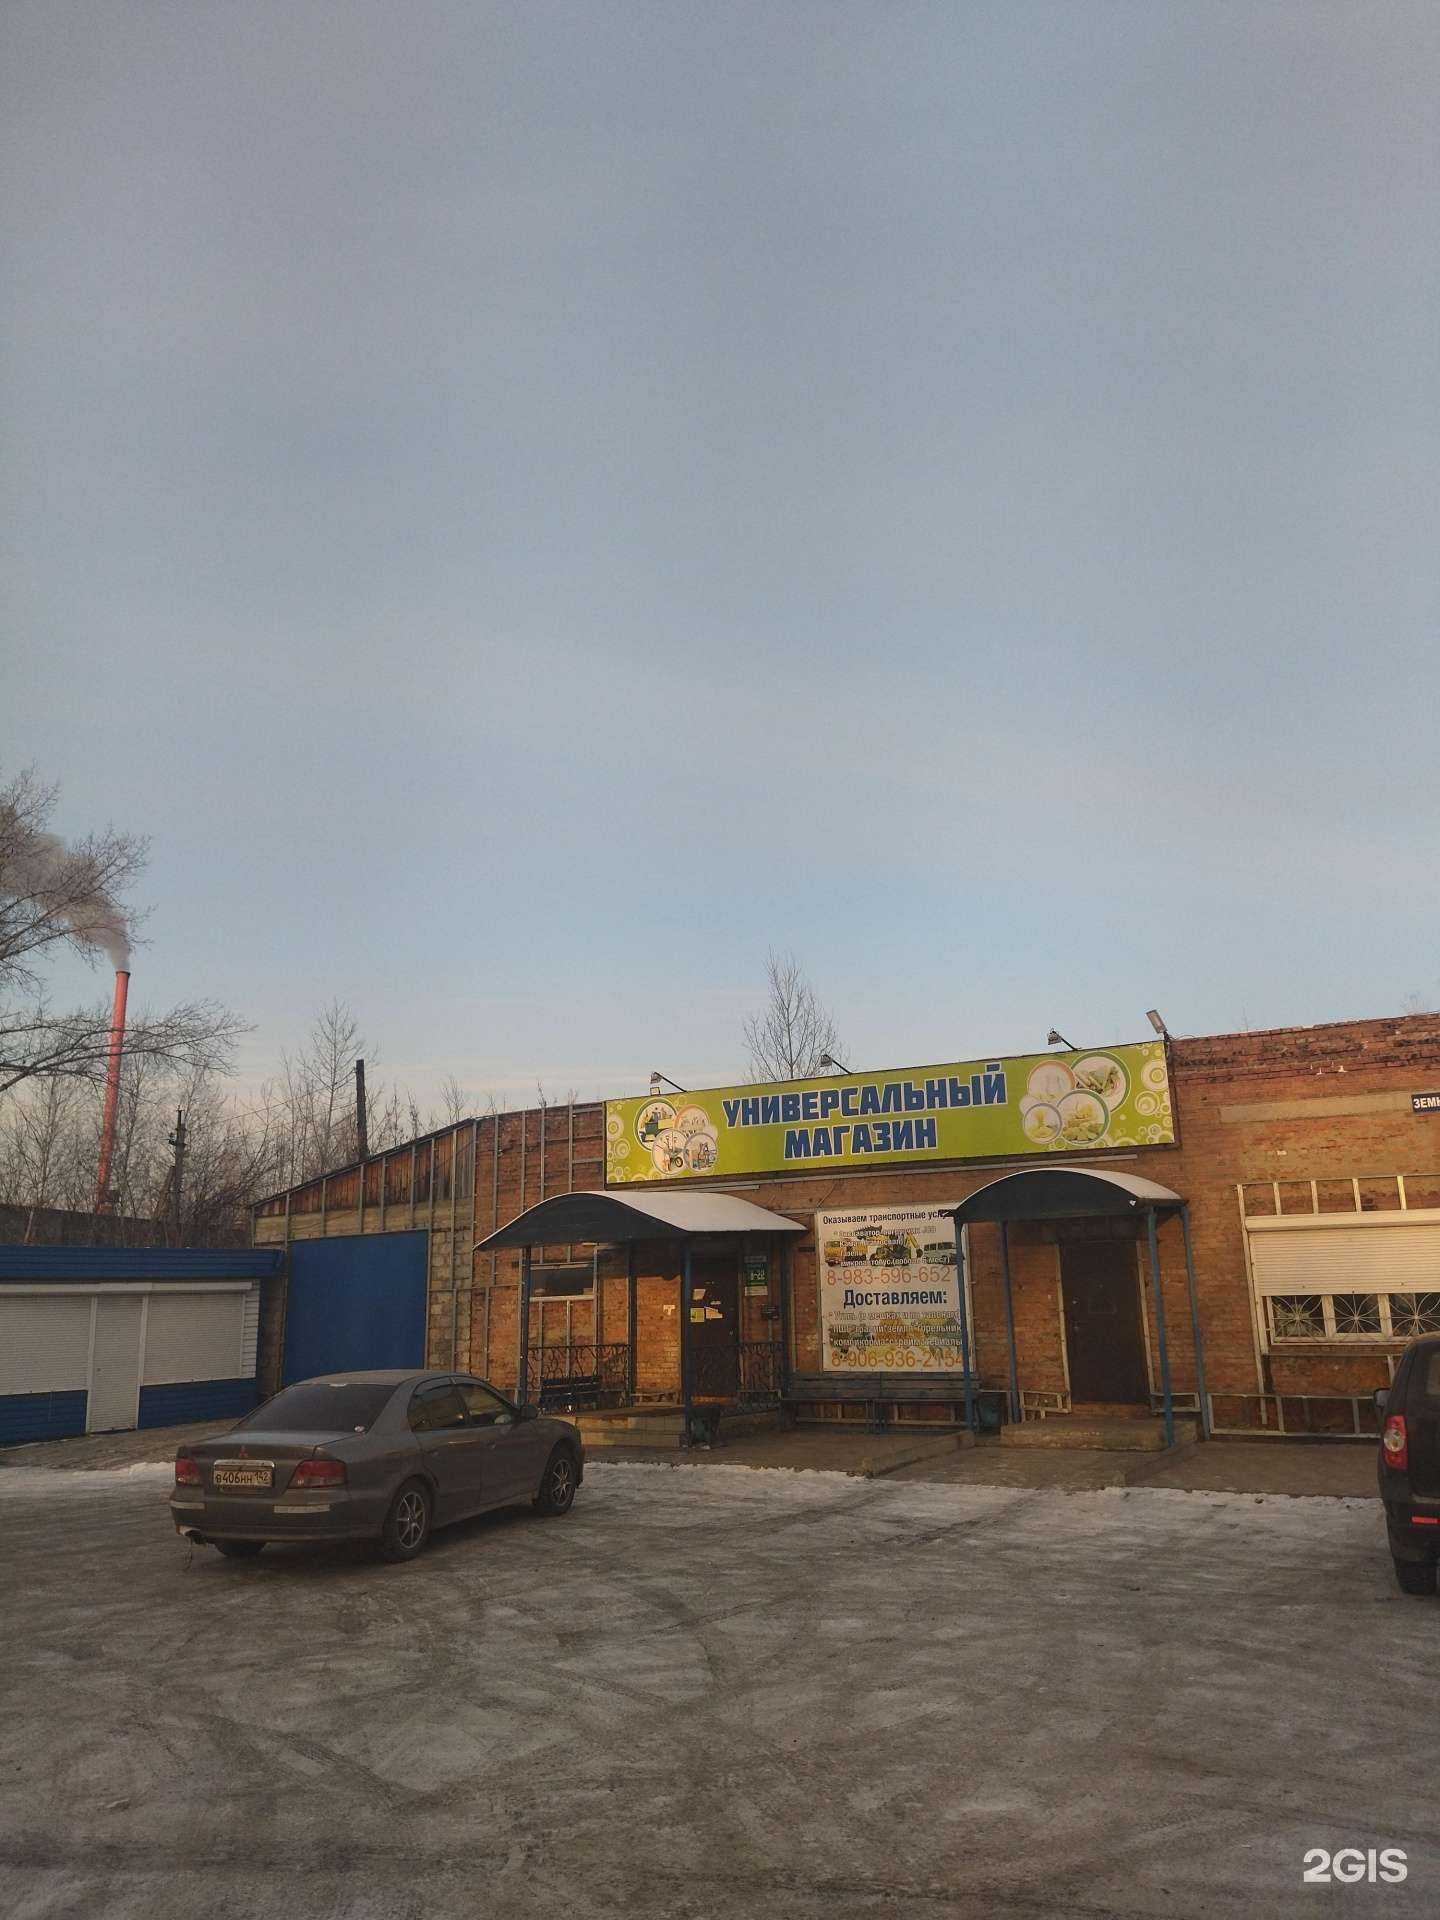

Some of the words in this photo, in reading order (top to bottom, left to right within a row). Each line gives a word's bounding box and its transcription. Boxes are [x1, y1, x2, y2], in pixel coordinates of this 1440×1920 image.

[722, 1062, 1008, 1129] УНИВЕРСАЛЬНЫЙ
[784, 1117, 937, 1161] МАГАЗИН
[823, 1215, 868, 1225] Оказываем
[869, 1211, 926, 1223] транспортные
[928, 1210, 946, 1220] усл
[827, 1267, 958, 1286] 8-983-596-652
[843, 1289, 947, 1309] Доставляем:
